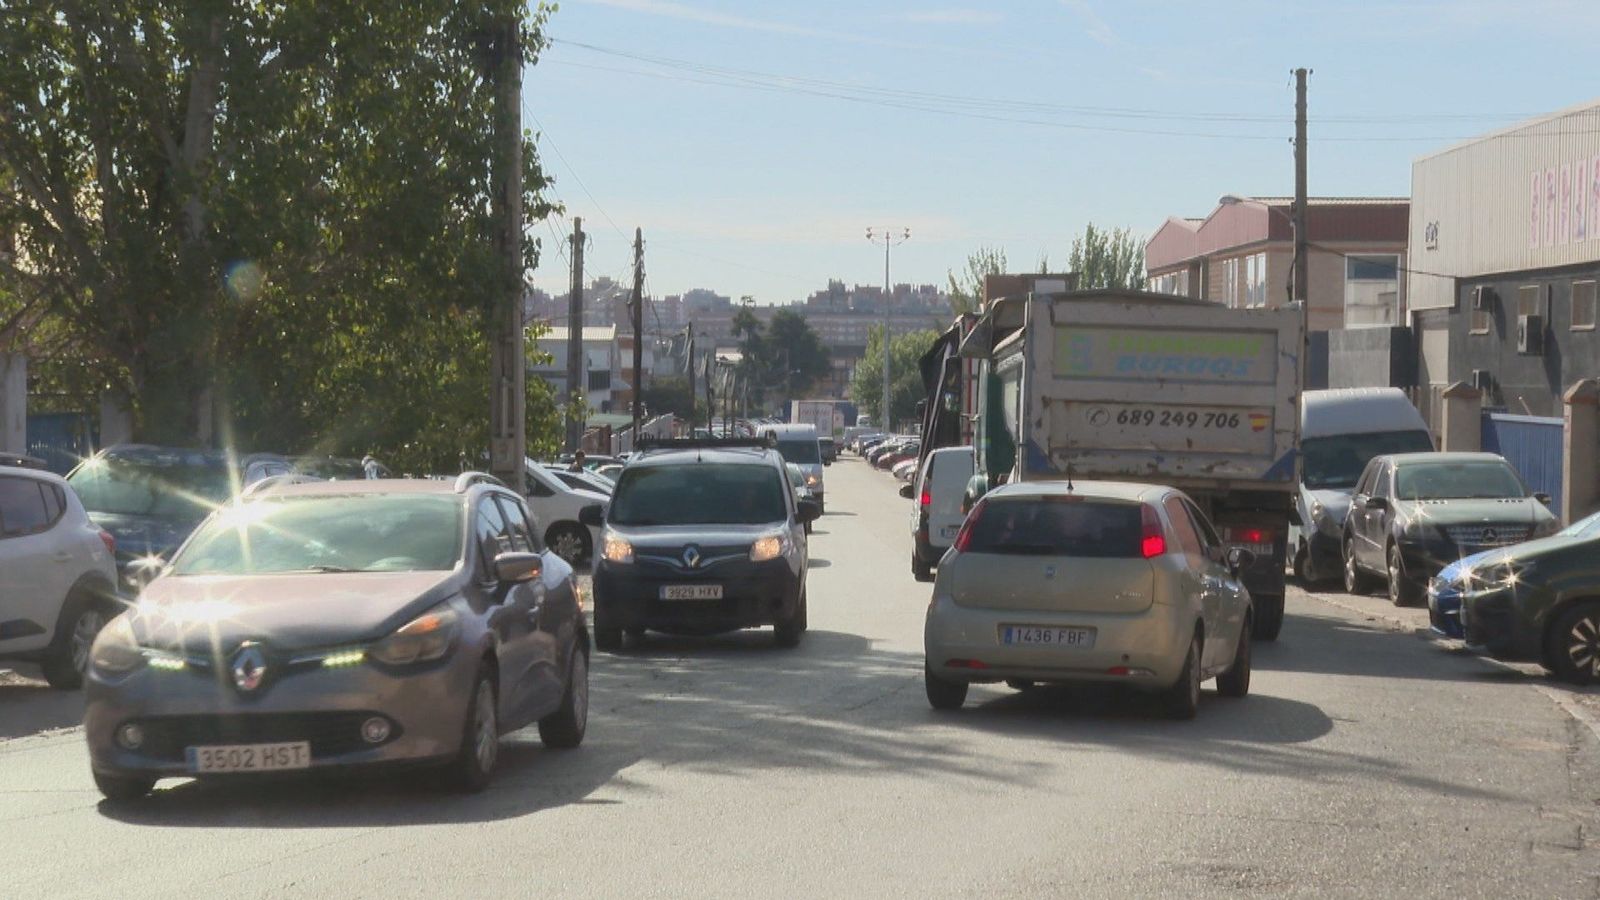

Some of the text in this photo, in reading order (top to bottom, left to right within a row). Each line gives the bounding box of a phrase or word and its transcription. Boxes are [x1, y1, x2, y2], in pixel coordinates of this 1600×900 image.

[1117, 409, 1240, 429] 689 249 706
[1017, 629, 1087, 645] 1436 FBF
[202, 745, 302, 769] 3502 HST
